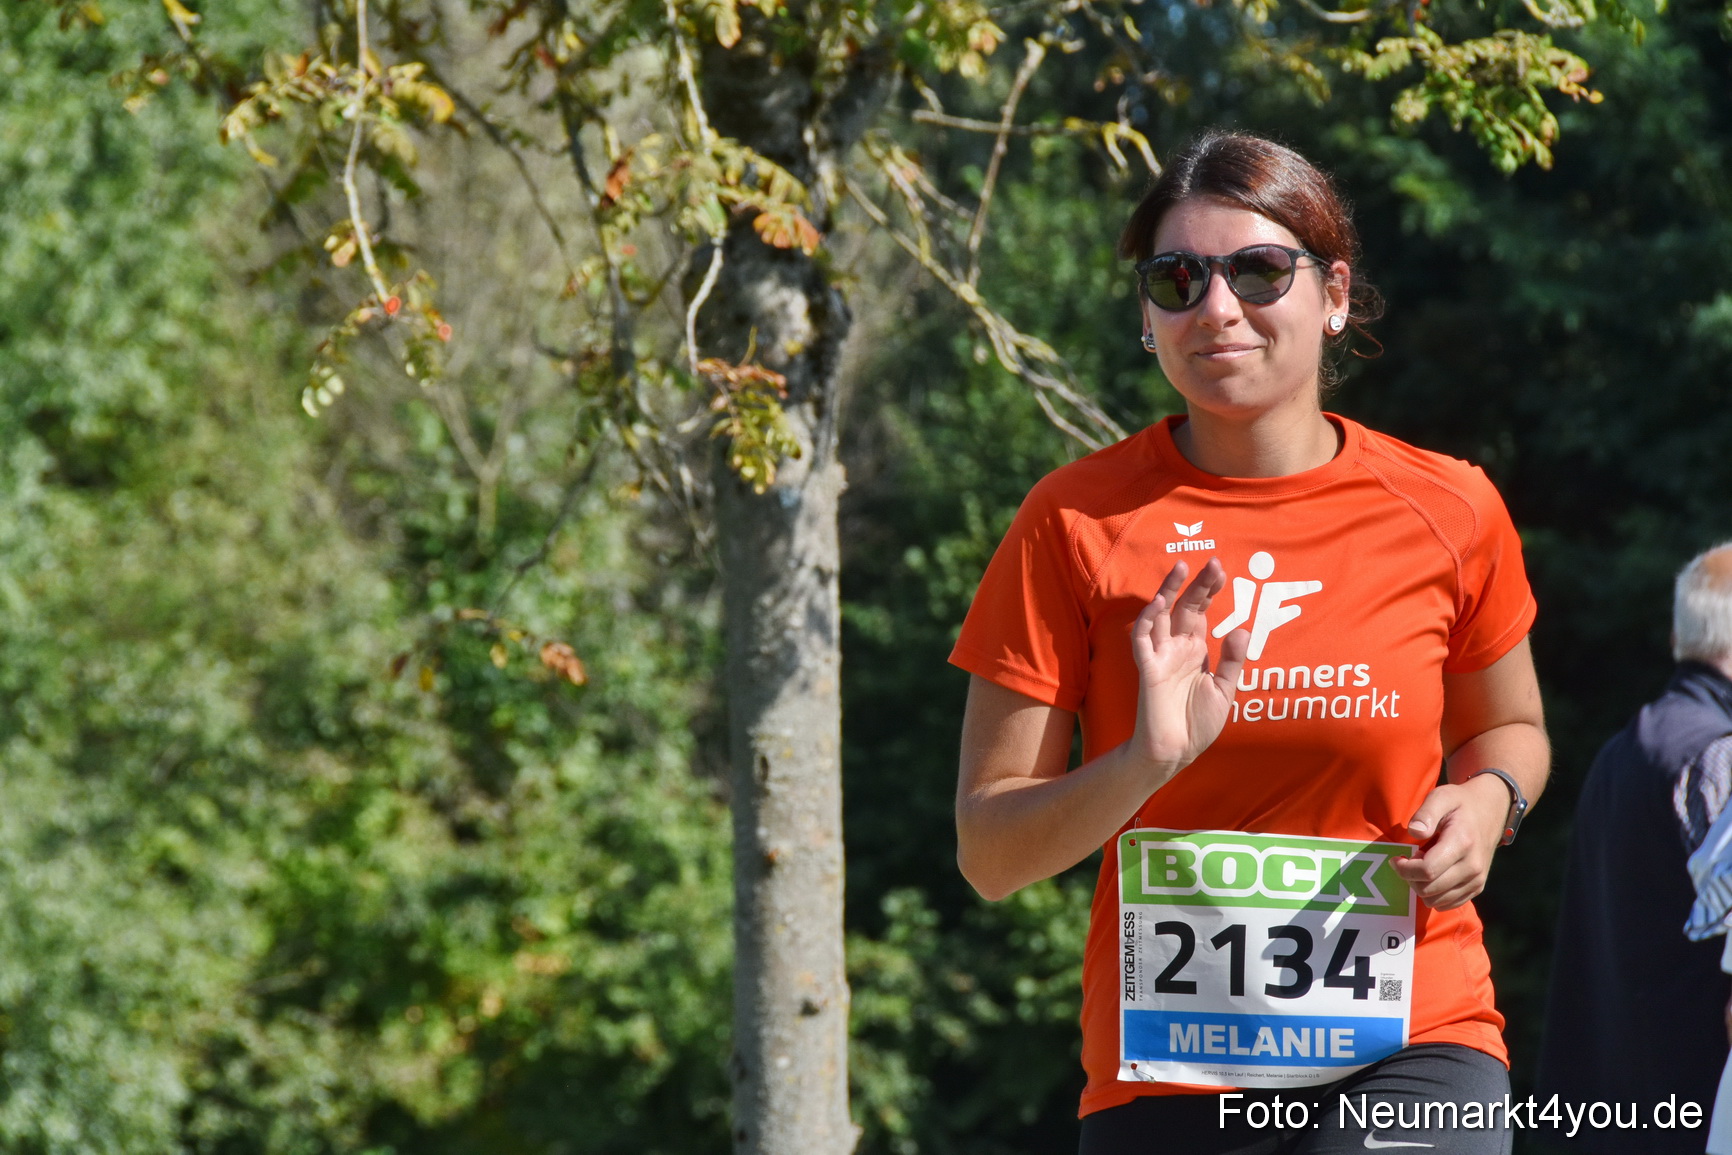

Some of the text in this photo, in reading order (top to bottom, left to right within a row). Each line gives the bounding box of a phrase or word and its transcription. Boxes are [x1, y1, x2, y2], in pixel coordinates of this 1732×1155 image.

[1165, 538, 1216, 554] erima
[1235, 663, 1371, 692] unners
[1140, 840, 1390, 907] BOCK
[1387, 935, 1400, 950] D
[1154, 920, 1376, 1001] 2134
[1169, 1023, 1356, 1059] MELANIE
